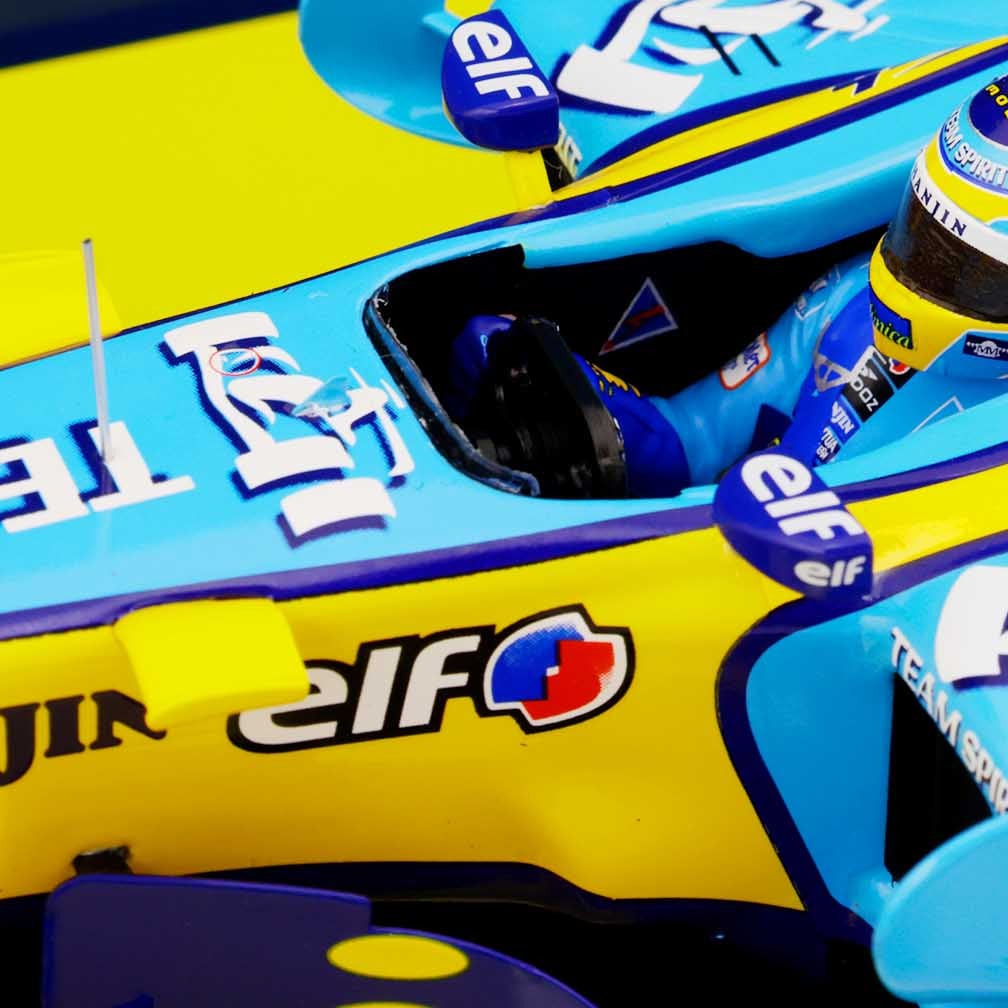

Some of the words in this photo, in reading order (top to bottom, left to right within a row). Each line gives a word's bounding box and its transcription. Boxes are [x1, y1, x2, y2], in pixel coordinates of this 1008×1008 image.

[452, 21, 549, 99] elf
[741, 454, 866, 540] elf
[794, 555, 867, 587] elf
[232, 632, 486, 749] elf
[891, 626, 963, 747] TEAM
